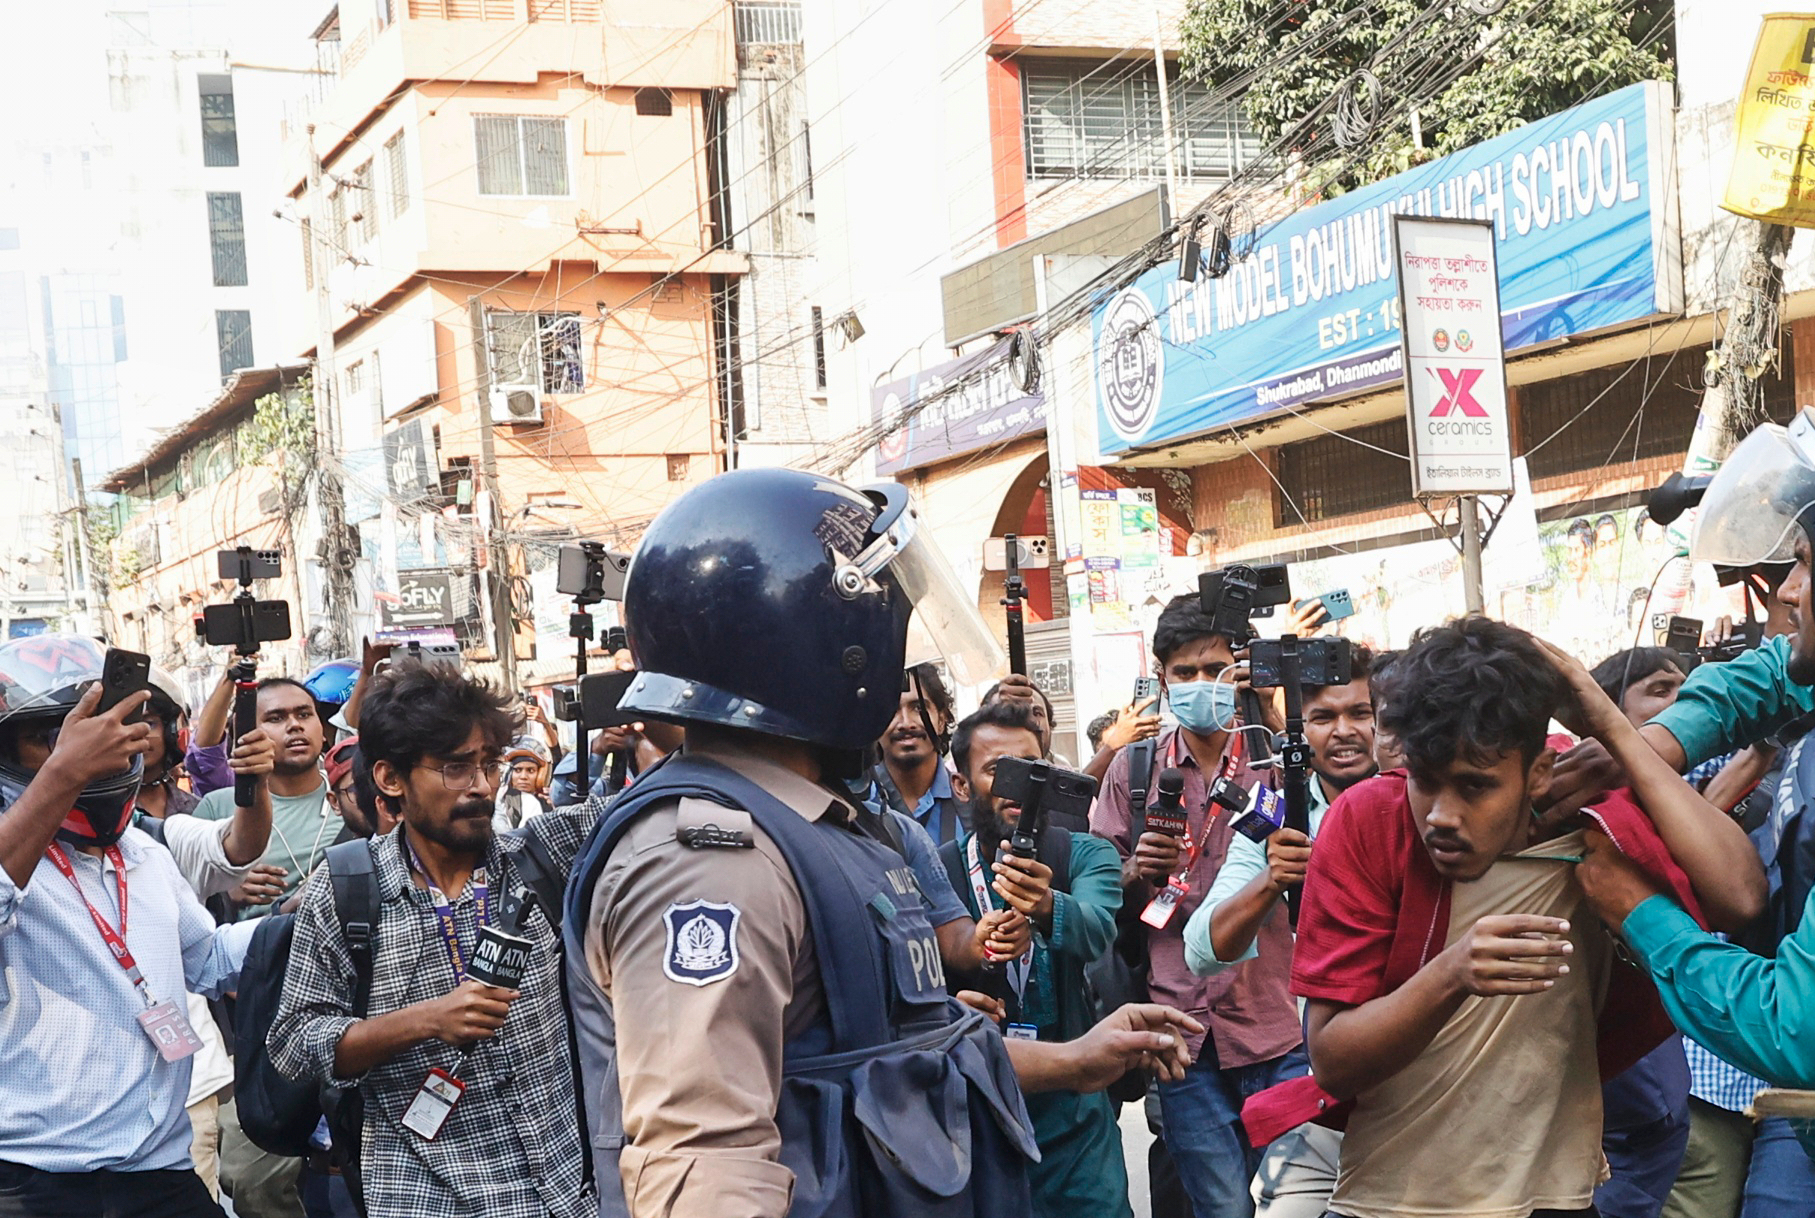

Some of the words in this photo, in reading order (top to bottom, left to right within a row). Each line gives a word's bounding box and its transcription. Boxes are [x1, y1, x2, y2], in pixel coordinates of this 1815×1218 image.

[1167, 268, 1213, 345] NEW
[1215, 243, 1290, 332] MODEL
[1290, 187, 1432, 307] BOHUMU
[1511, 117, 1640, 236] SCHOOL
[1428, 272, 1469, 294] পুলিশকে
[1416, 296, 1454, 312] সহায়তা
[1456, 298, 1483, 312] করুন
[1318, 307, 1361, 350] EST
[1256, 372, 1326, 407] Shukrabad,
[1326, 351, 1402, 389] Dhanmondi
[1428, 419, 1493, 435] ceramics
[1261, 787, 1276, 818] global
[48, 845, 67, 869] Limited
[475, 896, 486, 916] Ltd.
[92, 910, 110, 936] Limited
[442, 915, 455, 936] ATN
[449, 937, 463, 976] Bangla
[476, 938, 502, 963] ATN
[472, 955, 495, 975] BANGLA
[500, 947, 529, 969] ATN
[907, 936, 946, 992] POL
[496, 965, 521, 980] BANGLA
